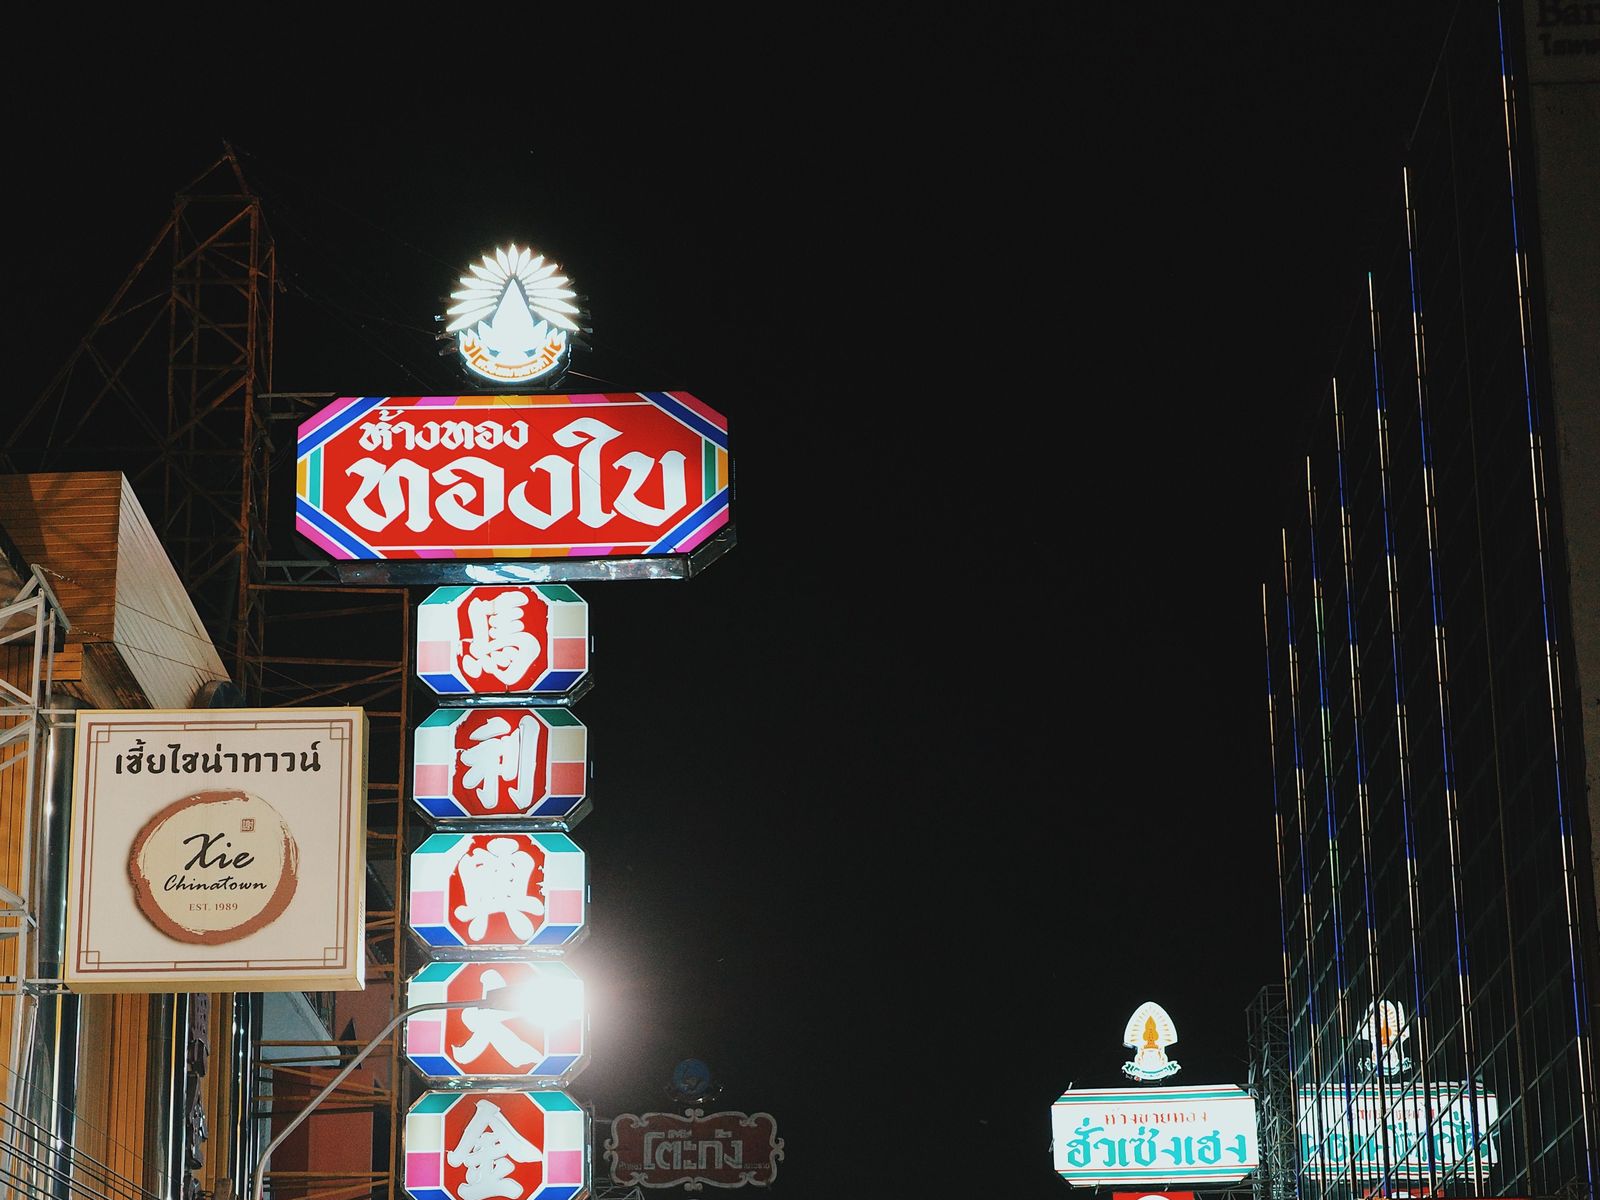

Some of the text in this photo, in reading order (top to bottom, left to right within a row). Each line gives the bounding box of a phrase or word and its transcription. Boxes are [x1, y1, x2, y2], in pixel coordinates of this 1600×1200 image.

[359, 407, 530, 451] ห้างทอง
[345, 417, 687, 533] ทองใบ
[115, 738, 322, 775] เซี้ยไชน่าทาวน์
[183, 832, 255, 871] Xie
[163, 874, 268, 892] Chinatown
[189, 902, 238, 912] EST. 1989
[1066, 1117, 1249, 1168] ฮั่วเซ่งเฮง
